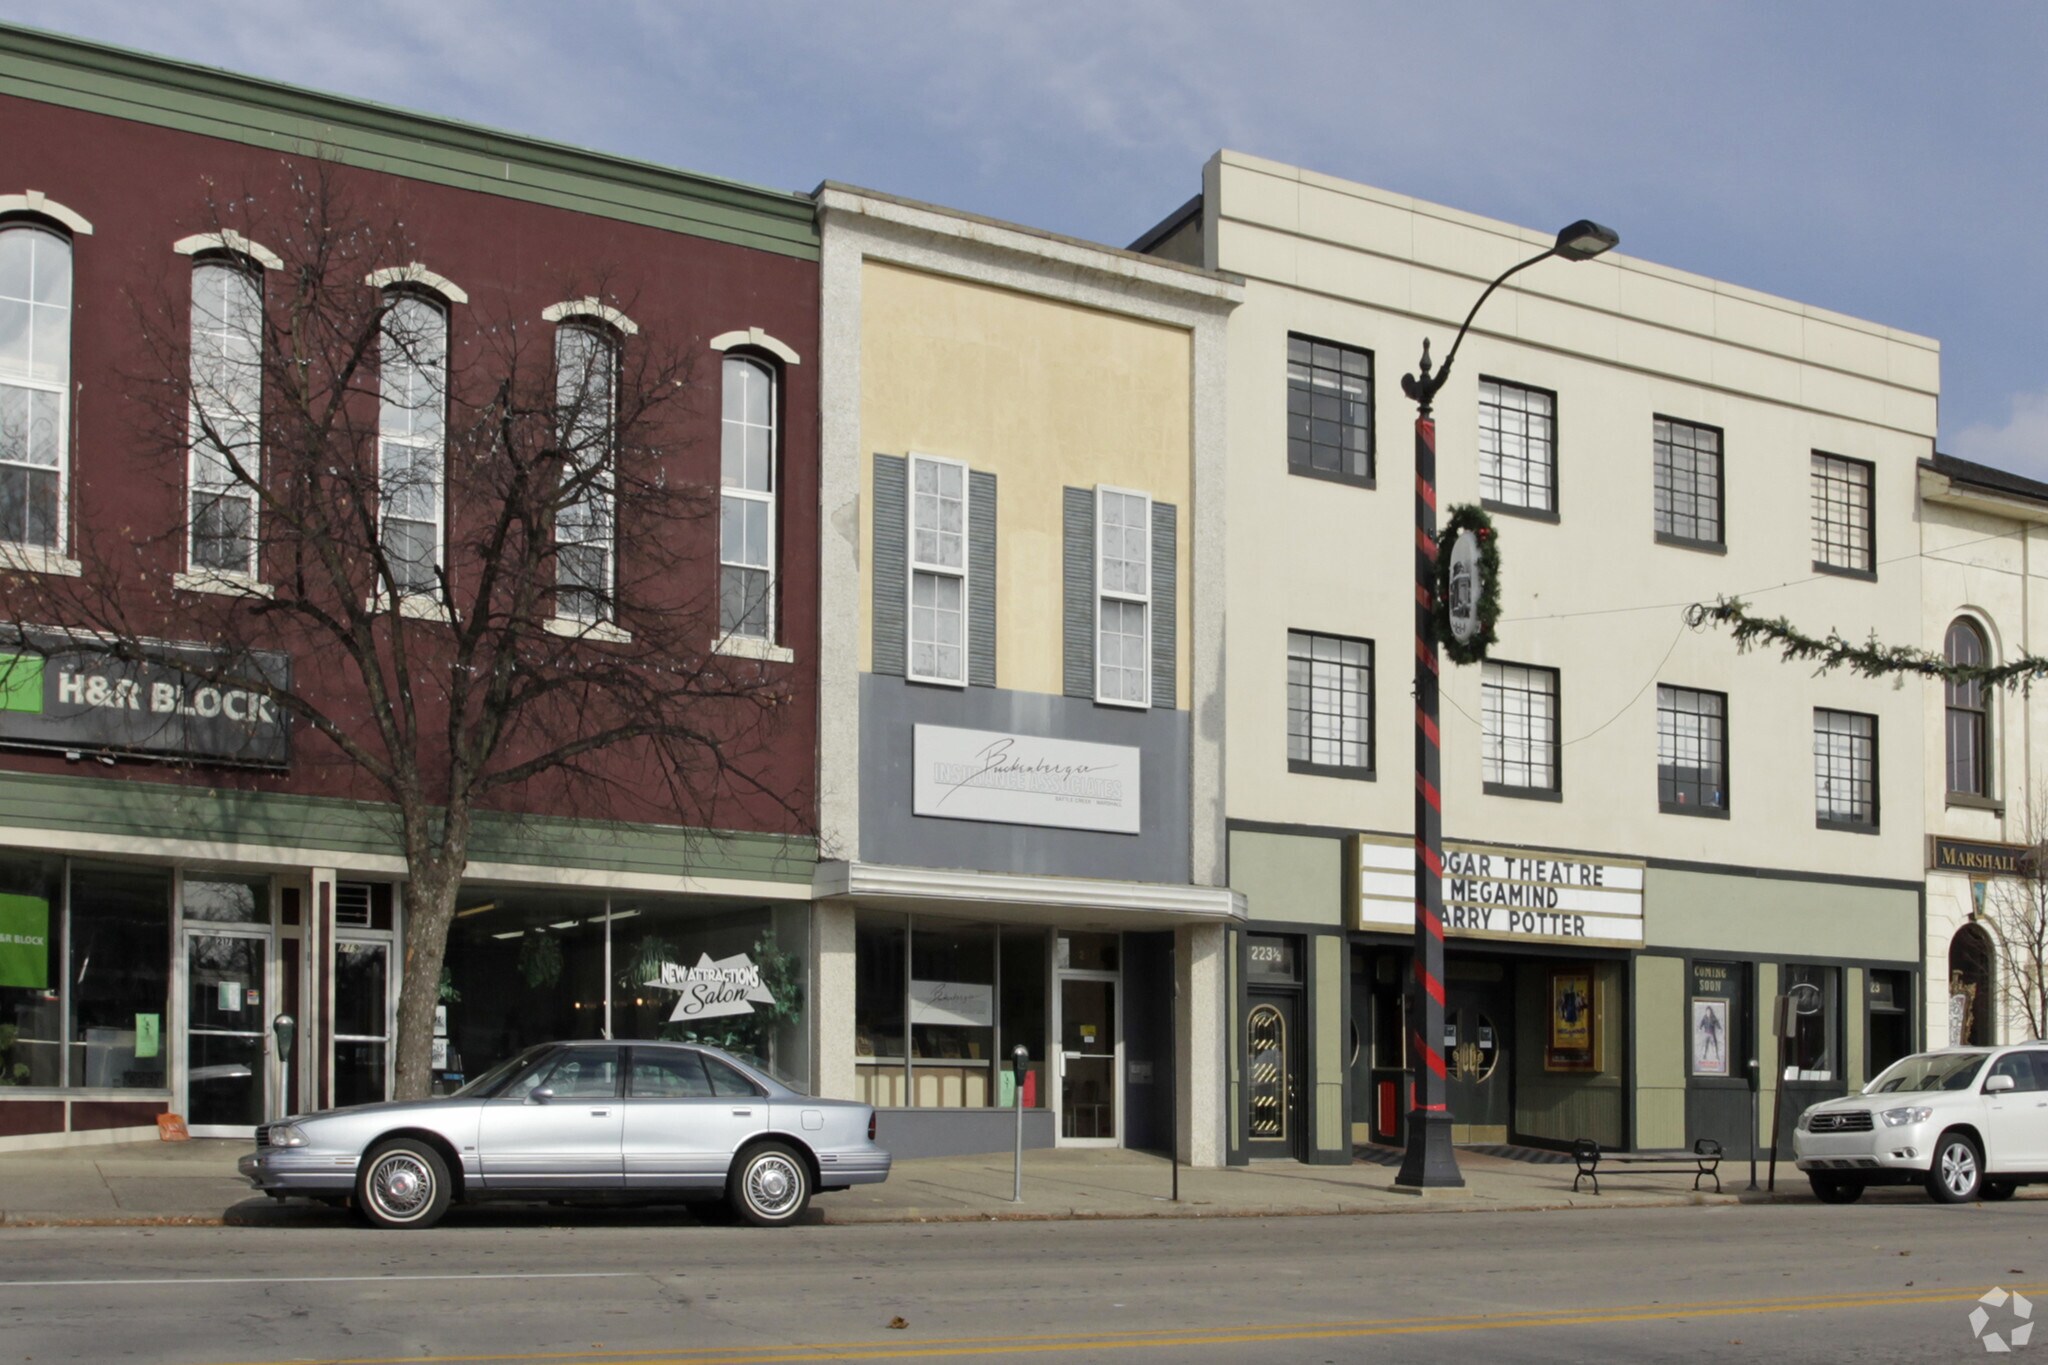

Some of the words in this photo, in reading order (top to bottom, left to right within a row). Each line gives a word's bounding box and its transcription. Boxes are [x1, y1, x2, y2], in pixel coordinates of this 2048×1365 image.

[58, 671, 141, 711] H&R
[150, 681, 275, 724] BLOCK
[933, 761, 1028, 789] INSURANCE
[1029, 771, 1123, 798] ASSOCIATES
[936, 737, 1119, 808] Buckenberger
[1441, 851, 1491, 877] GAR
[1504, 857, 1604, 887] THEATRE
[1942, 846, 2017, 872] MARSHALL
[1450, 879, 1558, 908] MEGAMIND
[1441, 904, 1492, 929] ARRY
[1509, 911, 1585, 937] POTTER
[14, 934, 44, 946] BLOCK
[661, 960, 687, 984] NEW
[687, 965, 760, 988] ATTRACTIONS
[1694, 965, 1727, 979] COMING
[1699, 979, 1721, 992] SOON
[684, 981, 749, 1015] Salon
